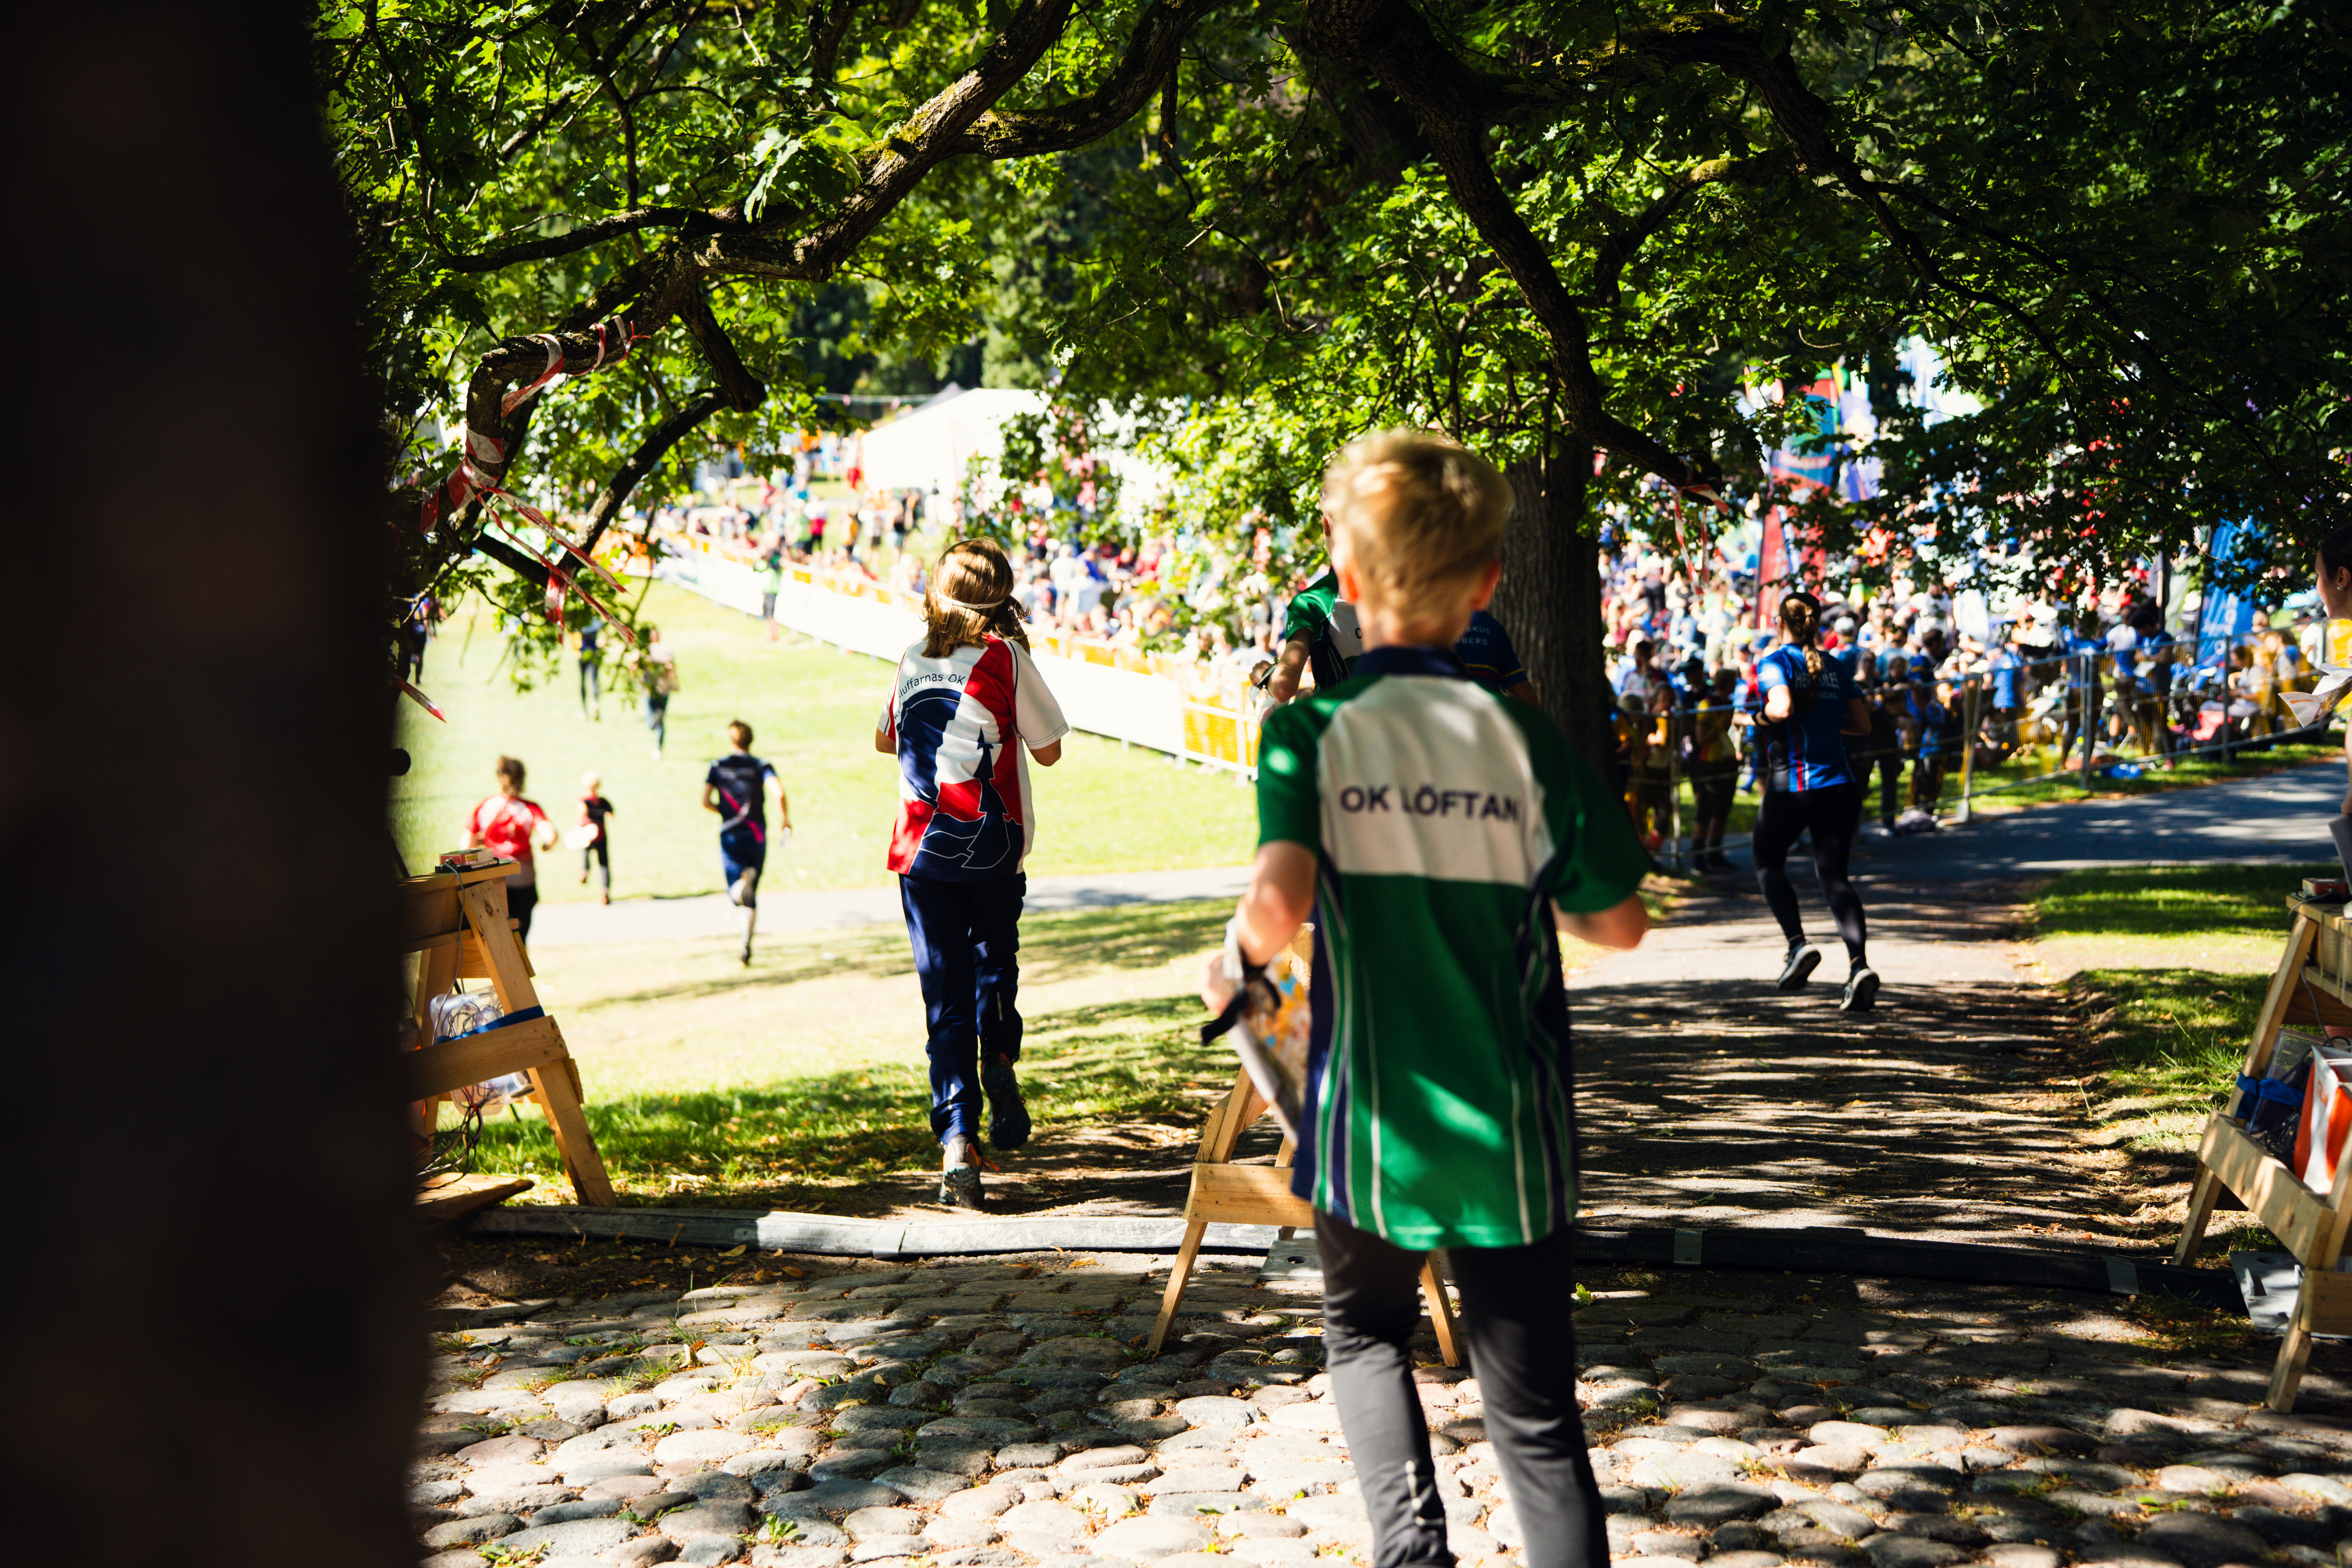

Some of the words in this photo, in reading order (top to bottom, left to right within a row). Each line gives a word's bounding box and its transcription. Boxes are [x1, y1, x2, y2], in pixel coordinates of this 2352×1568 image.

[948, 674, 966, 685] OK
[1339, 784, 1390, 813] OK
[1399, 784, 1520, 822] LÖFTAN
